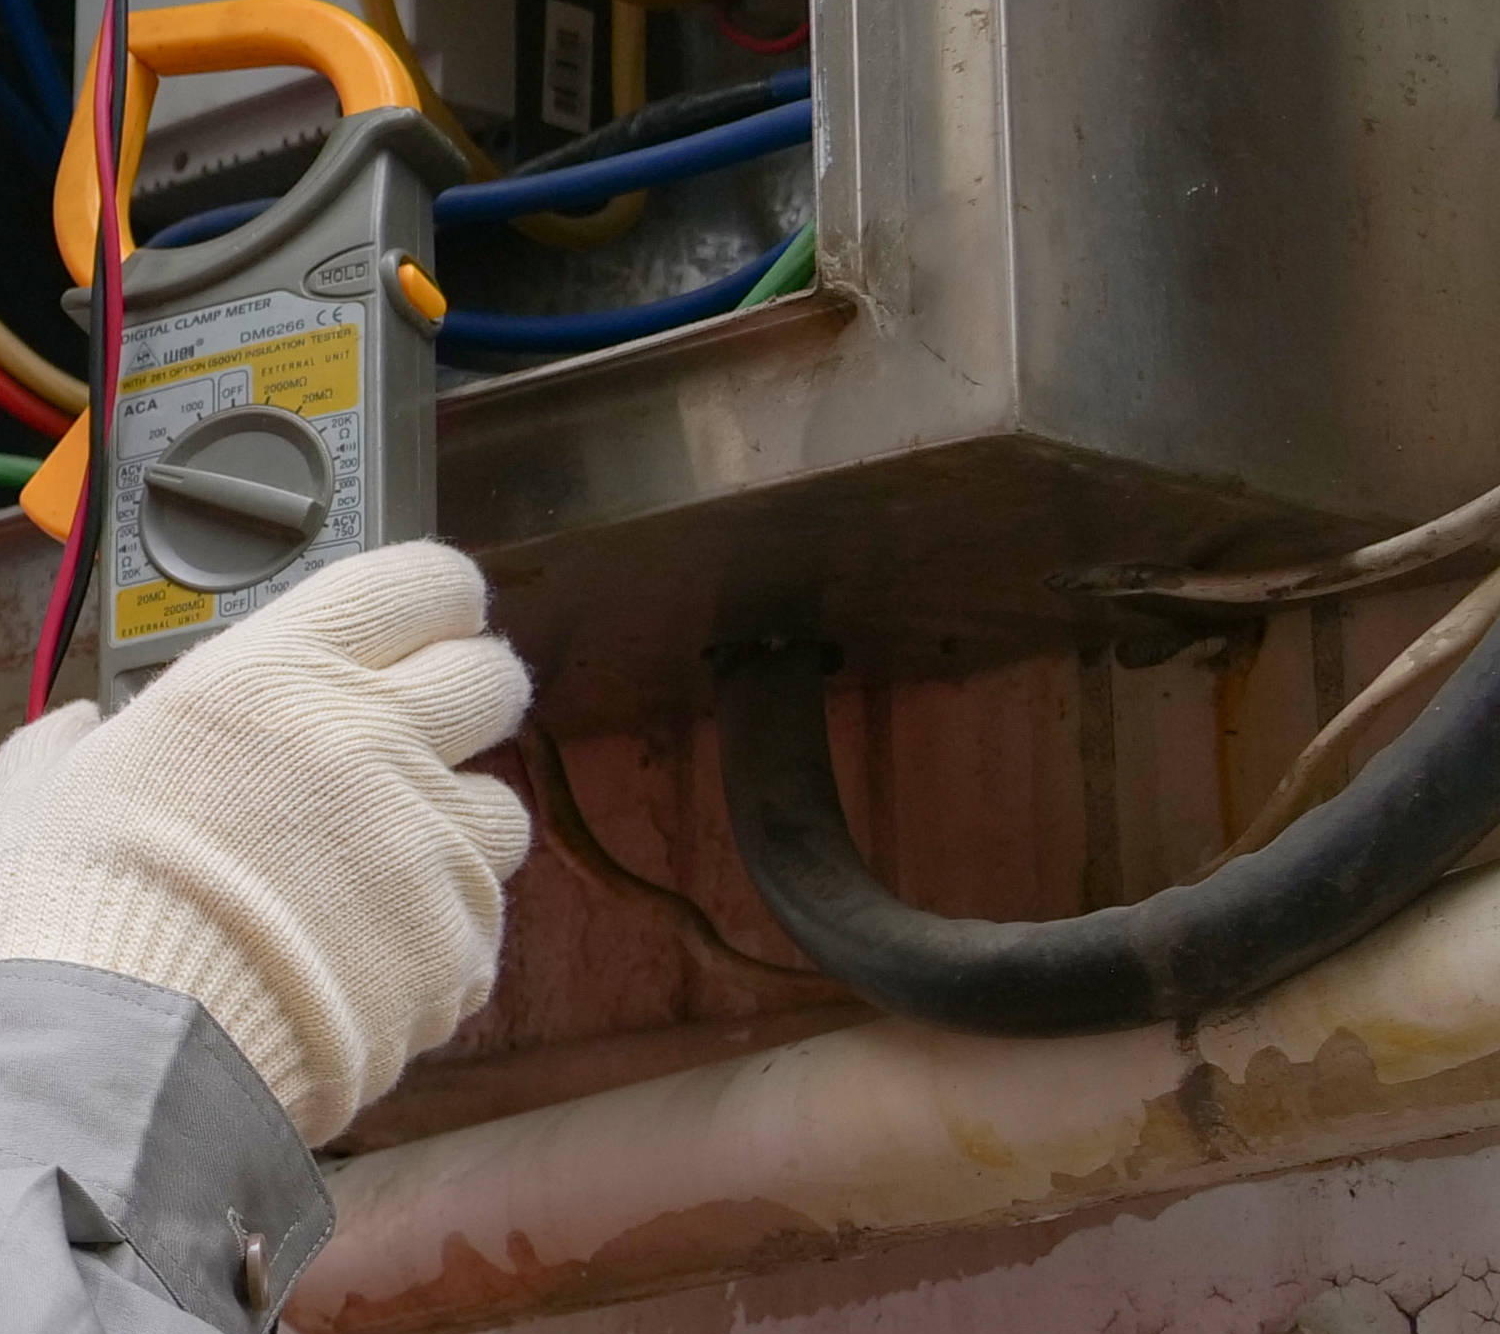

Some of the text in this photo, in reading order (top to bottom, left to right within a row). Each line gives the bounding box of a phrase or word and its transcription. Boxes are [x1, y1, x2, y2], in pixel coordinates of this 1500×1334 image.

[318, 262, 367, 285] HOLD
[121, 298, 272, 346] DIGITAL CLAMP METER
[240, 320, 305, 344] DM6266
[122, 375, 147, 390] WITH
[169, 363, 206, 378] OPTION
[207, 352, 243, 370] (500V)
[245, 338, 306, 359] INSULATION
[310, 328, 352, 346] TESTER
[261, 350, 350, 377] EXTERNAL UNIT
[221, 385, 244, 399] OFF
[124, 399, 158, 417] ACA
[181, 399, 204, 413] 1000
[331, 416, 353, 428] 20K
[148, 427, 167, 440] 200
[120, 463, 142, 477] ACV
[339, 457, 357, 470] 200
[337, 496, 356, 507] DCV
[332, 515, 356, 528] ACV
[334, 526, 355, 537] 750
[304, 559, 325, 572] 200
[122, 567, 142, 580] 20K
[265, 581, 290, 594] 1000
[224, 598, 246, 612] OFF
[121, 613, 201, 638] EXTERNAL UNIT
